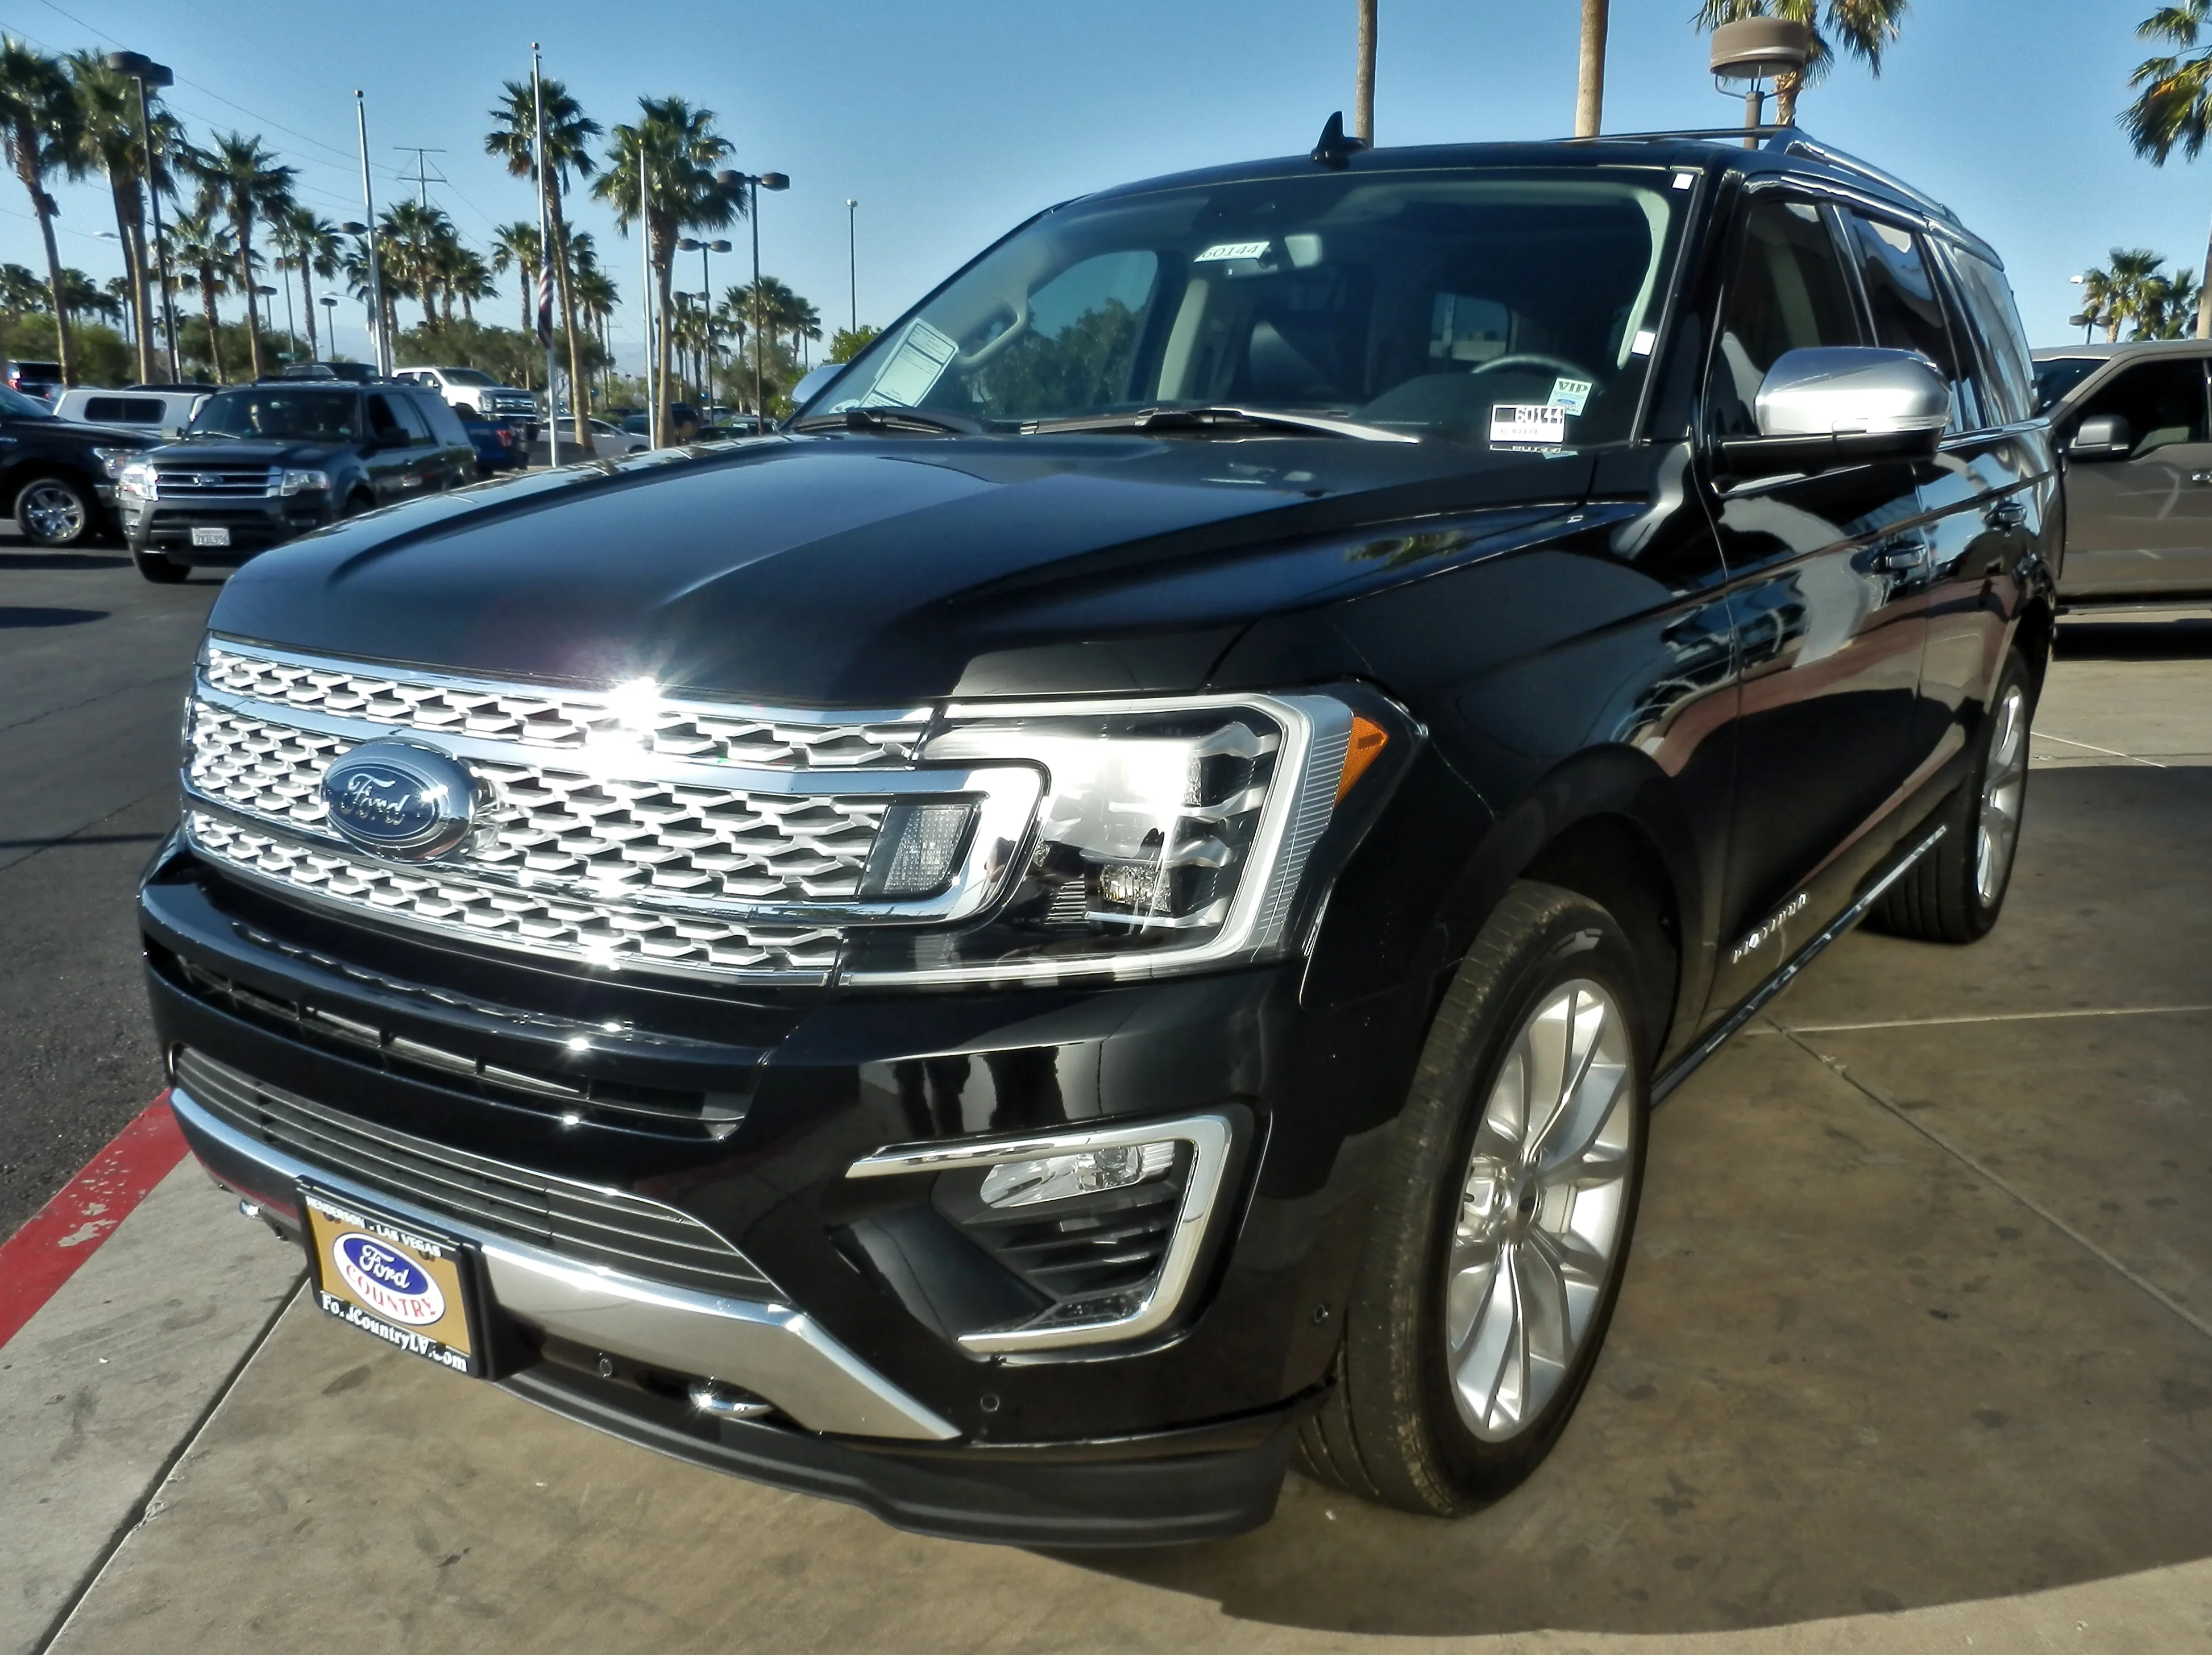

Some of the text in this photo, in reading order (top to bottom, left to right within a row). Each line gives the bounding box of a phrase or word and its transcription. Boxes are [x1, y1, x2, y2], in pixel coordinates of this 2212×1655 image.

[1202, 245, 1259, 258] 60144
[1558, 380, 1588, 394] VIP
[1514, 407, 1563, 424] 60144
[341, 773, 410, 826] Ford
[305, 1195, 366, 1230] HENDERSON
[376, 1223, 400, 1242] LAS
[400, 1234, 442, 1258] VEGAS
[358, 1244, 411, 1289] Ford
[346, 1264, 437, 1317] COUNTRY
